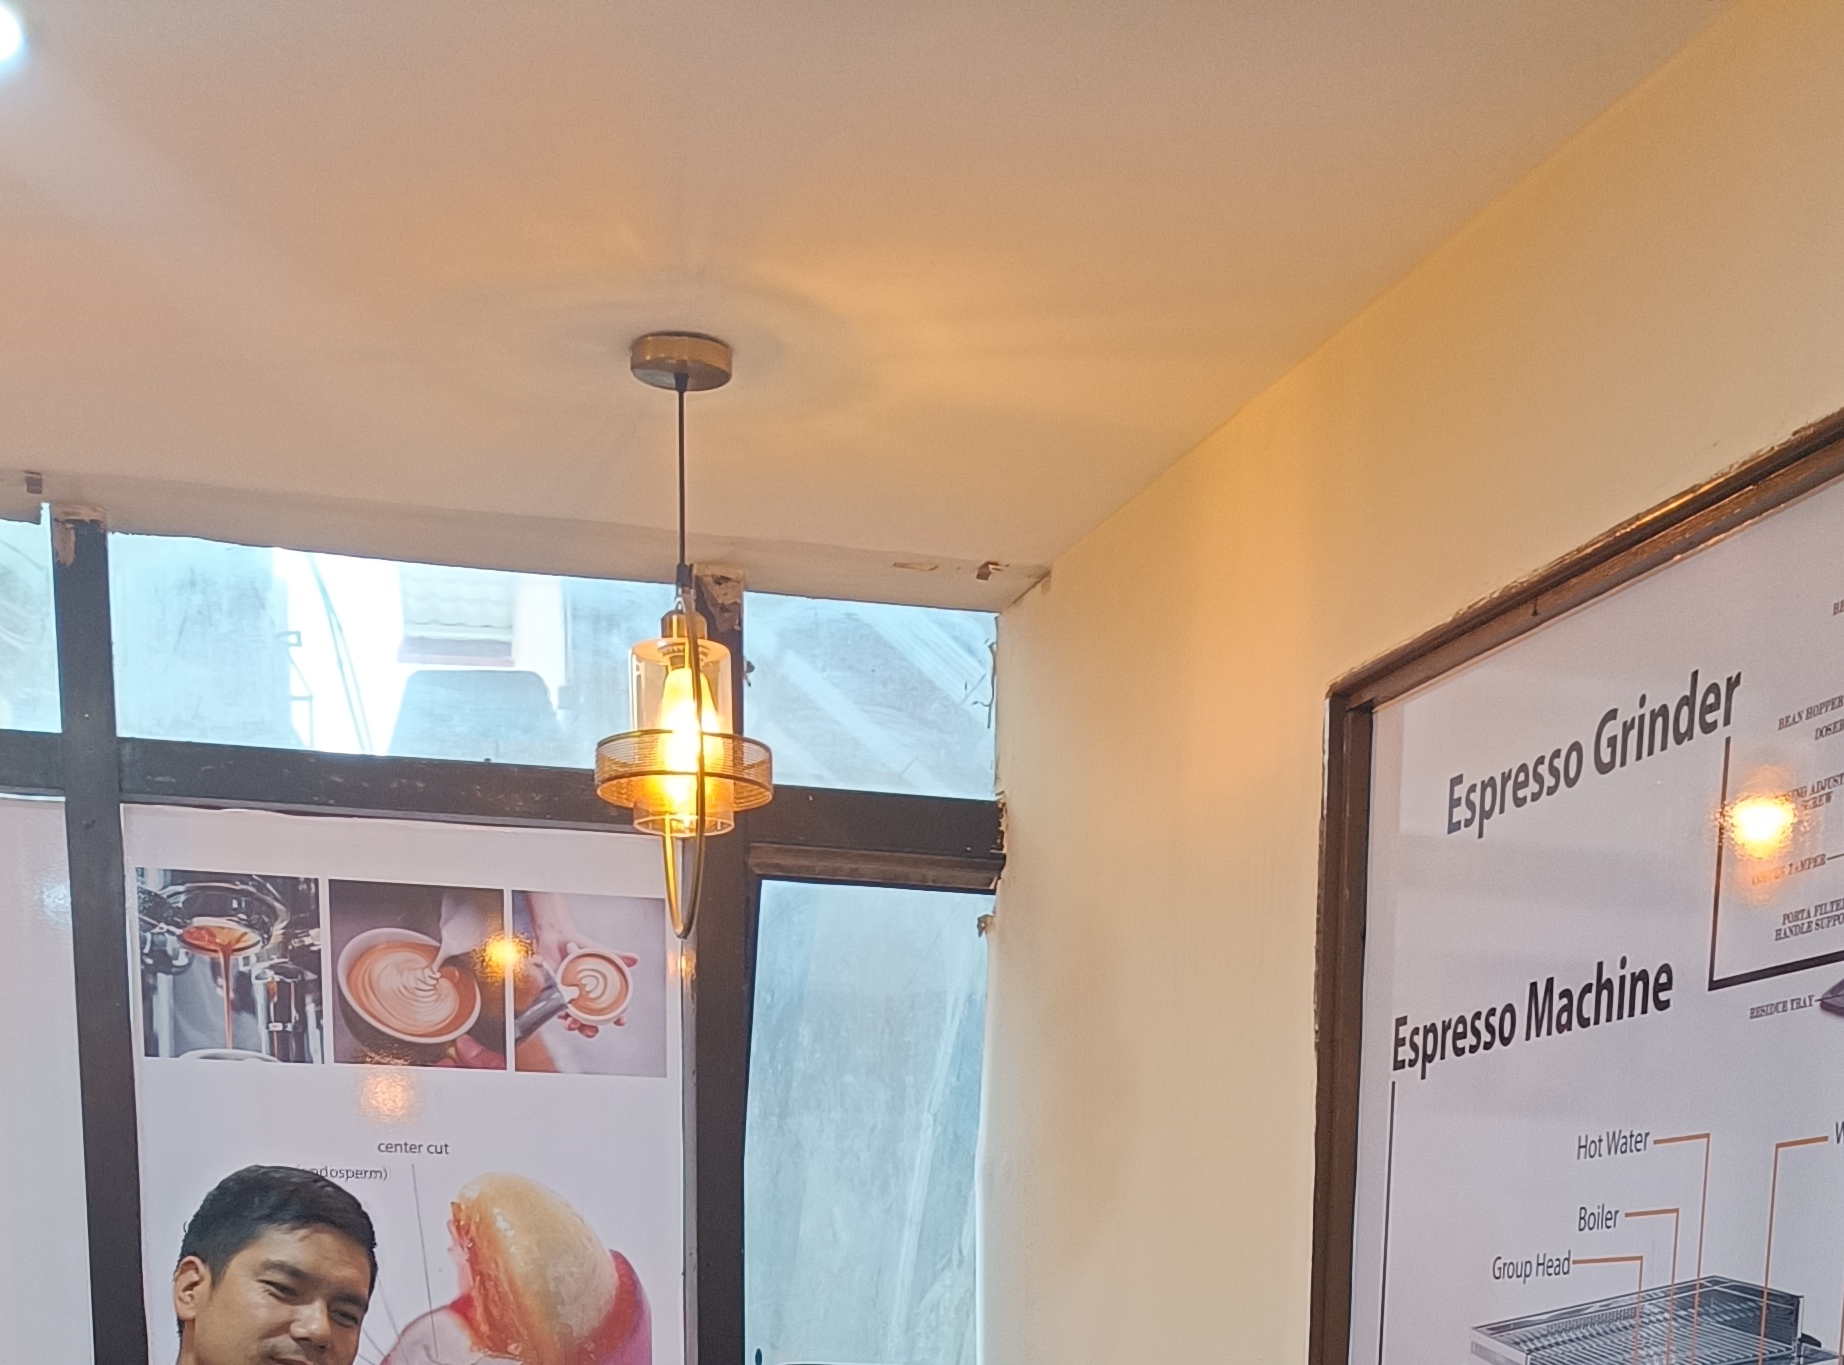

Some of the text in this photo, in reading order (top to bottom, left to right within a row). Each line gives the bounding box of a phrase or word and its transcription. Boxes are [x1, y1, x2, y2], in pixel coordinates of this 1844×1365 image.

[1778, 709, 1804, 731] BEAN
[1446, 668, 1743, 838] Espresso Grinder
[1782, 898, 1844, 926] PORTA FILTE
[1774, 920, 1814, 941] HANDLE
[1392, 955, 1675, 1081] Espresso Machine
[376, 1141, 450, 1155] center cut
[1577, 1128, 1651, 1161] Hot Water
[1578, 1203, 1620, 1232] Boiler
[1492, 1249, 1572, 1284] Group Head
